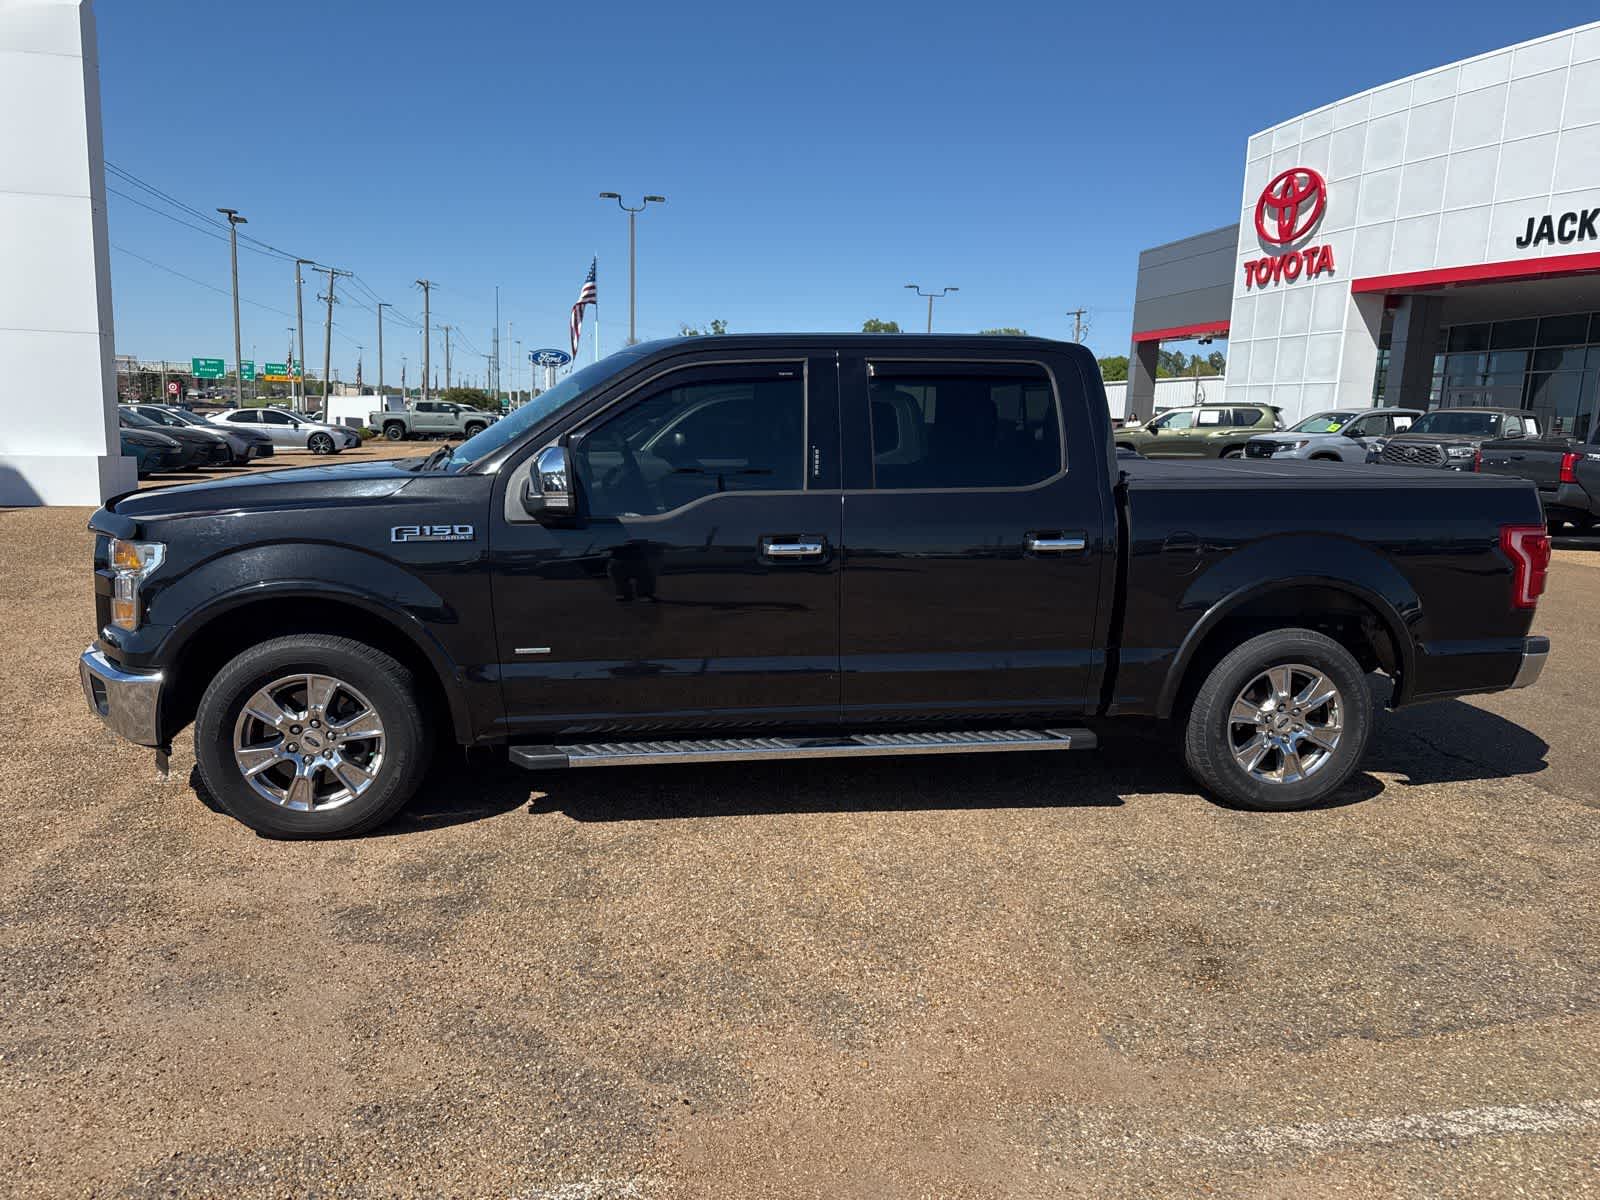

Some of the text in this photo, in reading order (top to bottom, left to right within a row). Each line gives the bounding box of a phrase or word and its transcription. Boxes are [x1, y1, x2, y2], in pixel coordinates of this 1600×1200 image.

[1516, 208, 1600, 248] JACK
[1244, 245, 1335, 288] TOYOTA
[537, 351, 563, 363] Ford
